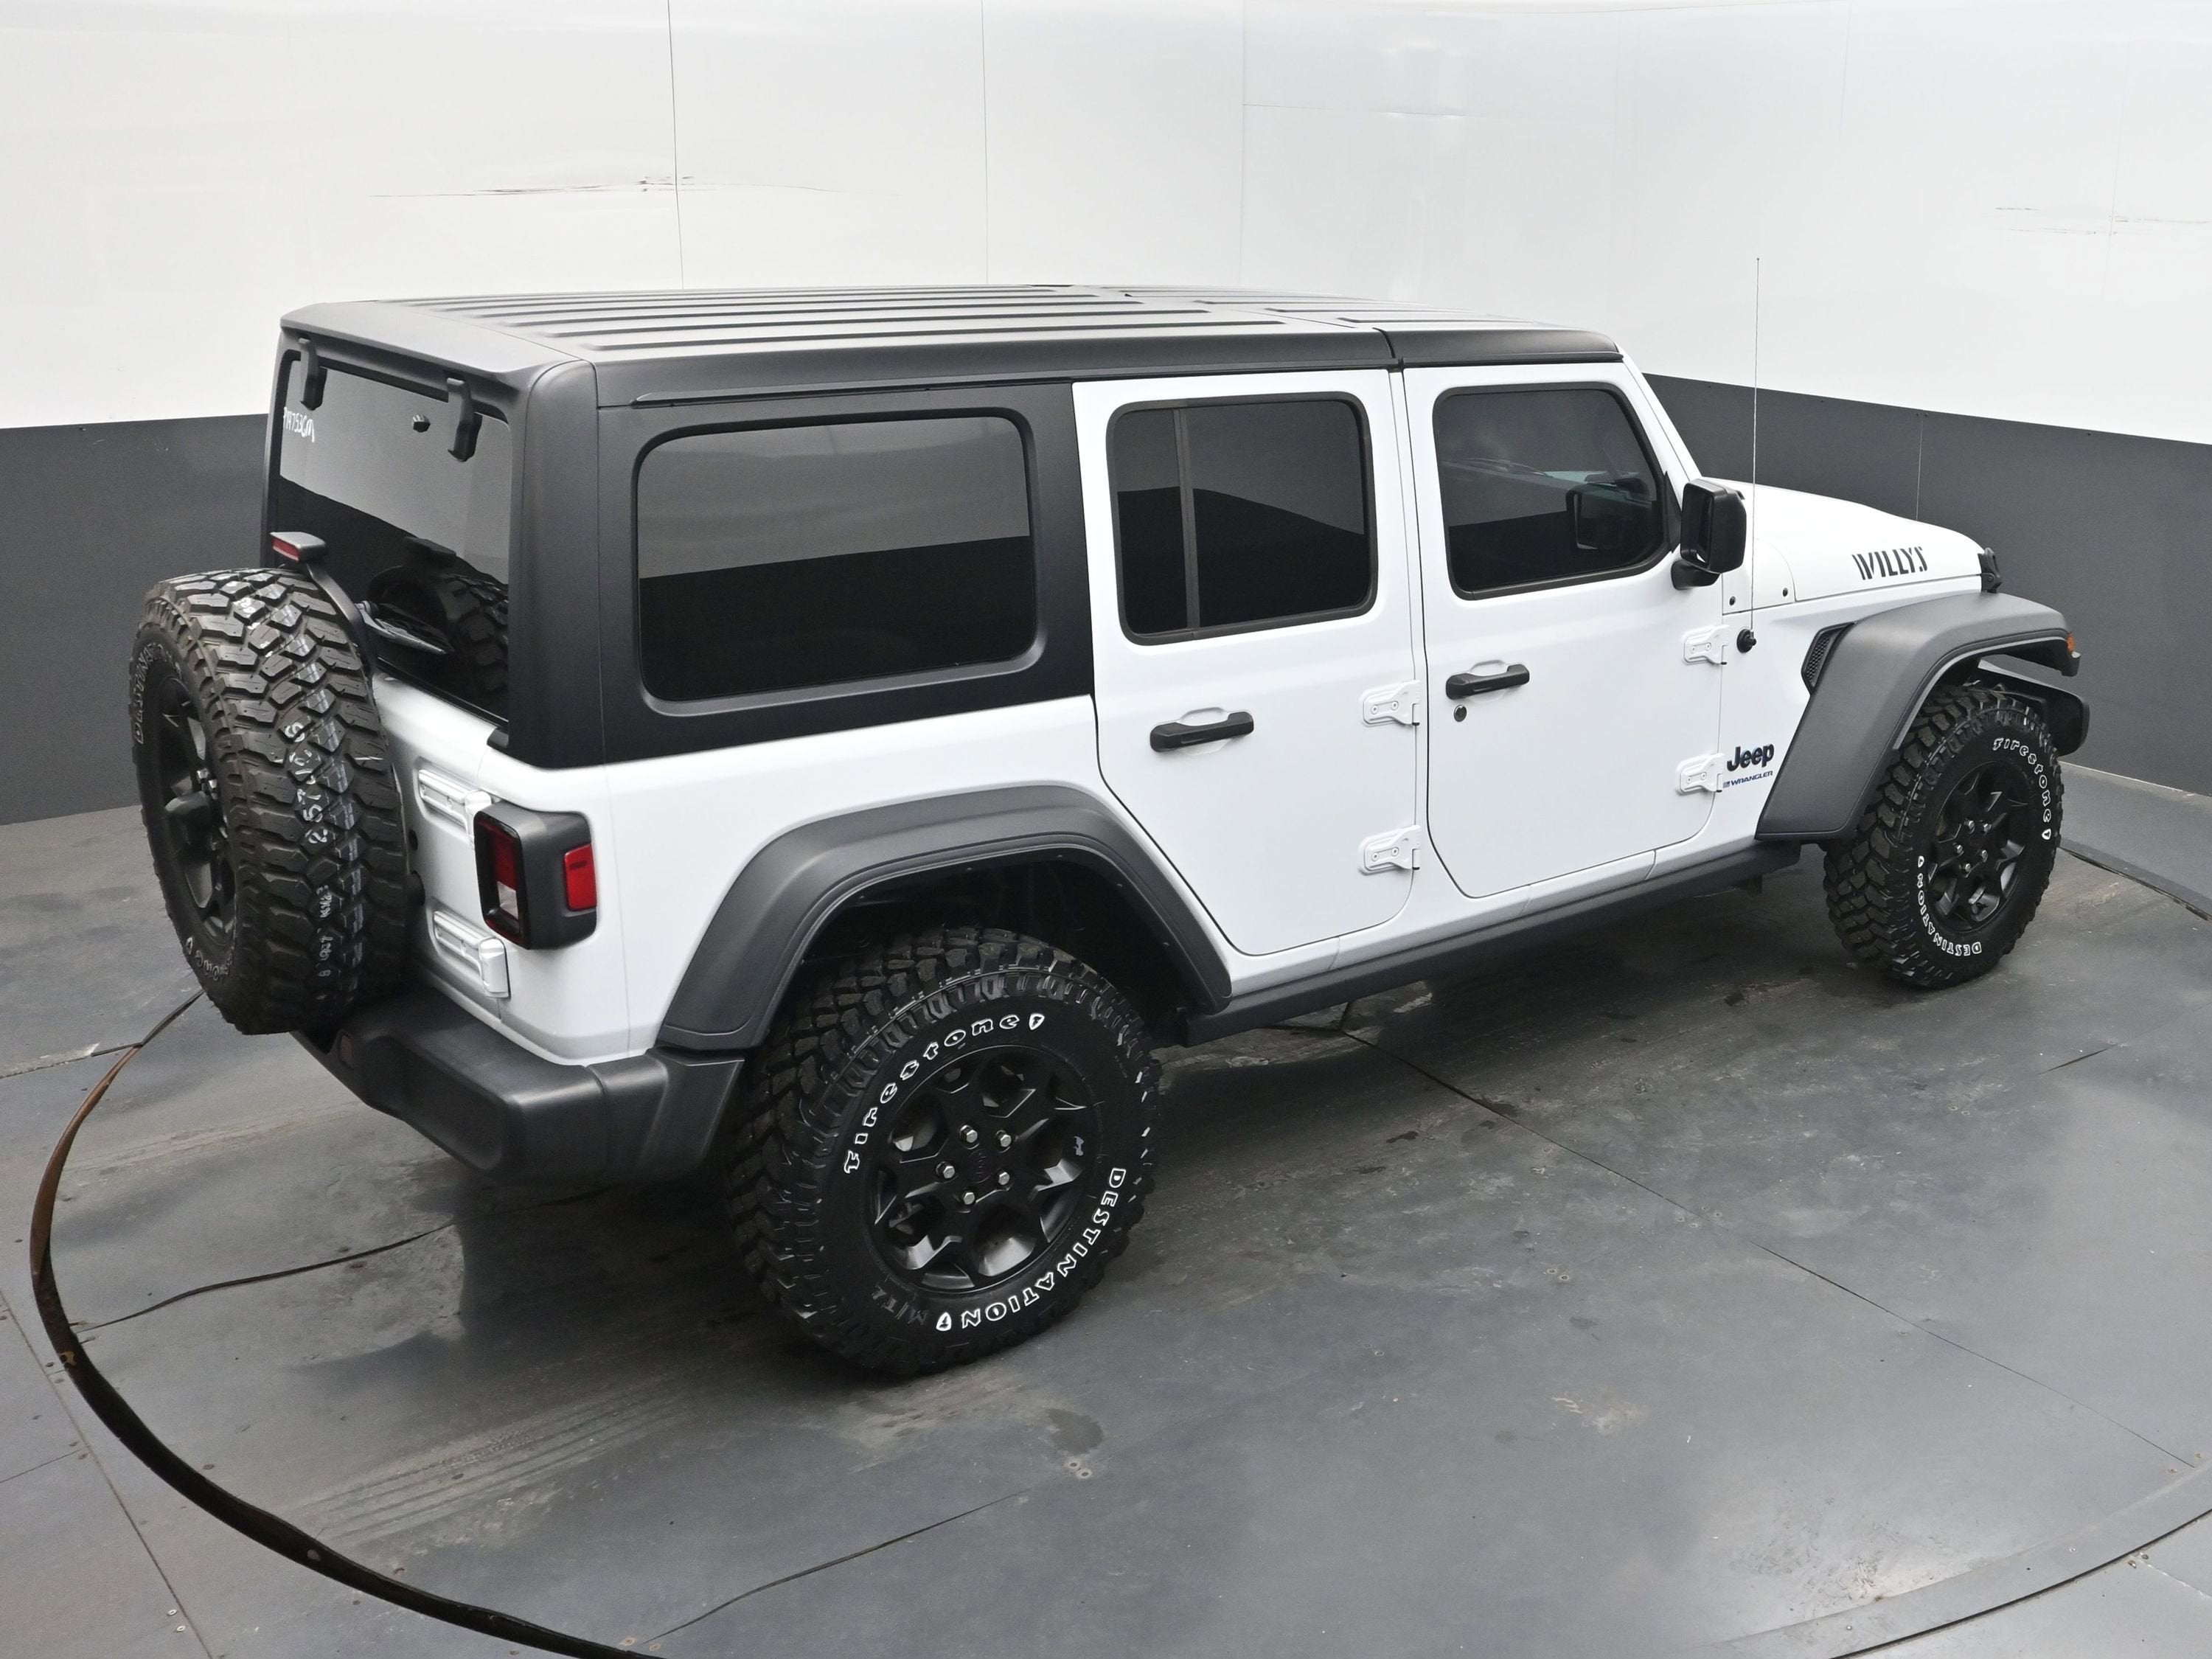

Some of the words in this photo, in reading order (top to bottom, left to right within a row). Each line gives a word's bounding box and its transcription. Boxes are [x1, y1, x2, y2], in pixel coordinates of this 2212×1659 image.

[1851, 546, 1928, 581] WILLYS
[1726, 743, 1775, 772] Jeep
[1731, 771, 1773, 787] WRANGLER
[1916, 872, 1983, 957] DESTINATION
[960, 1166, 1127, 1330] DESTINATION
